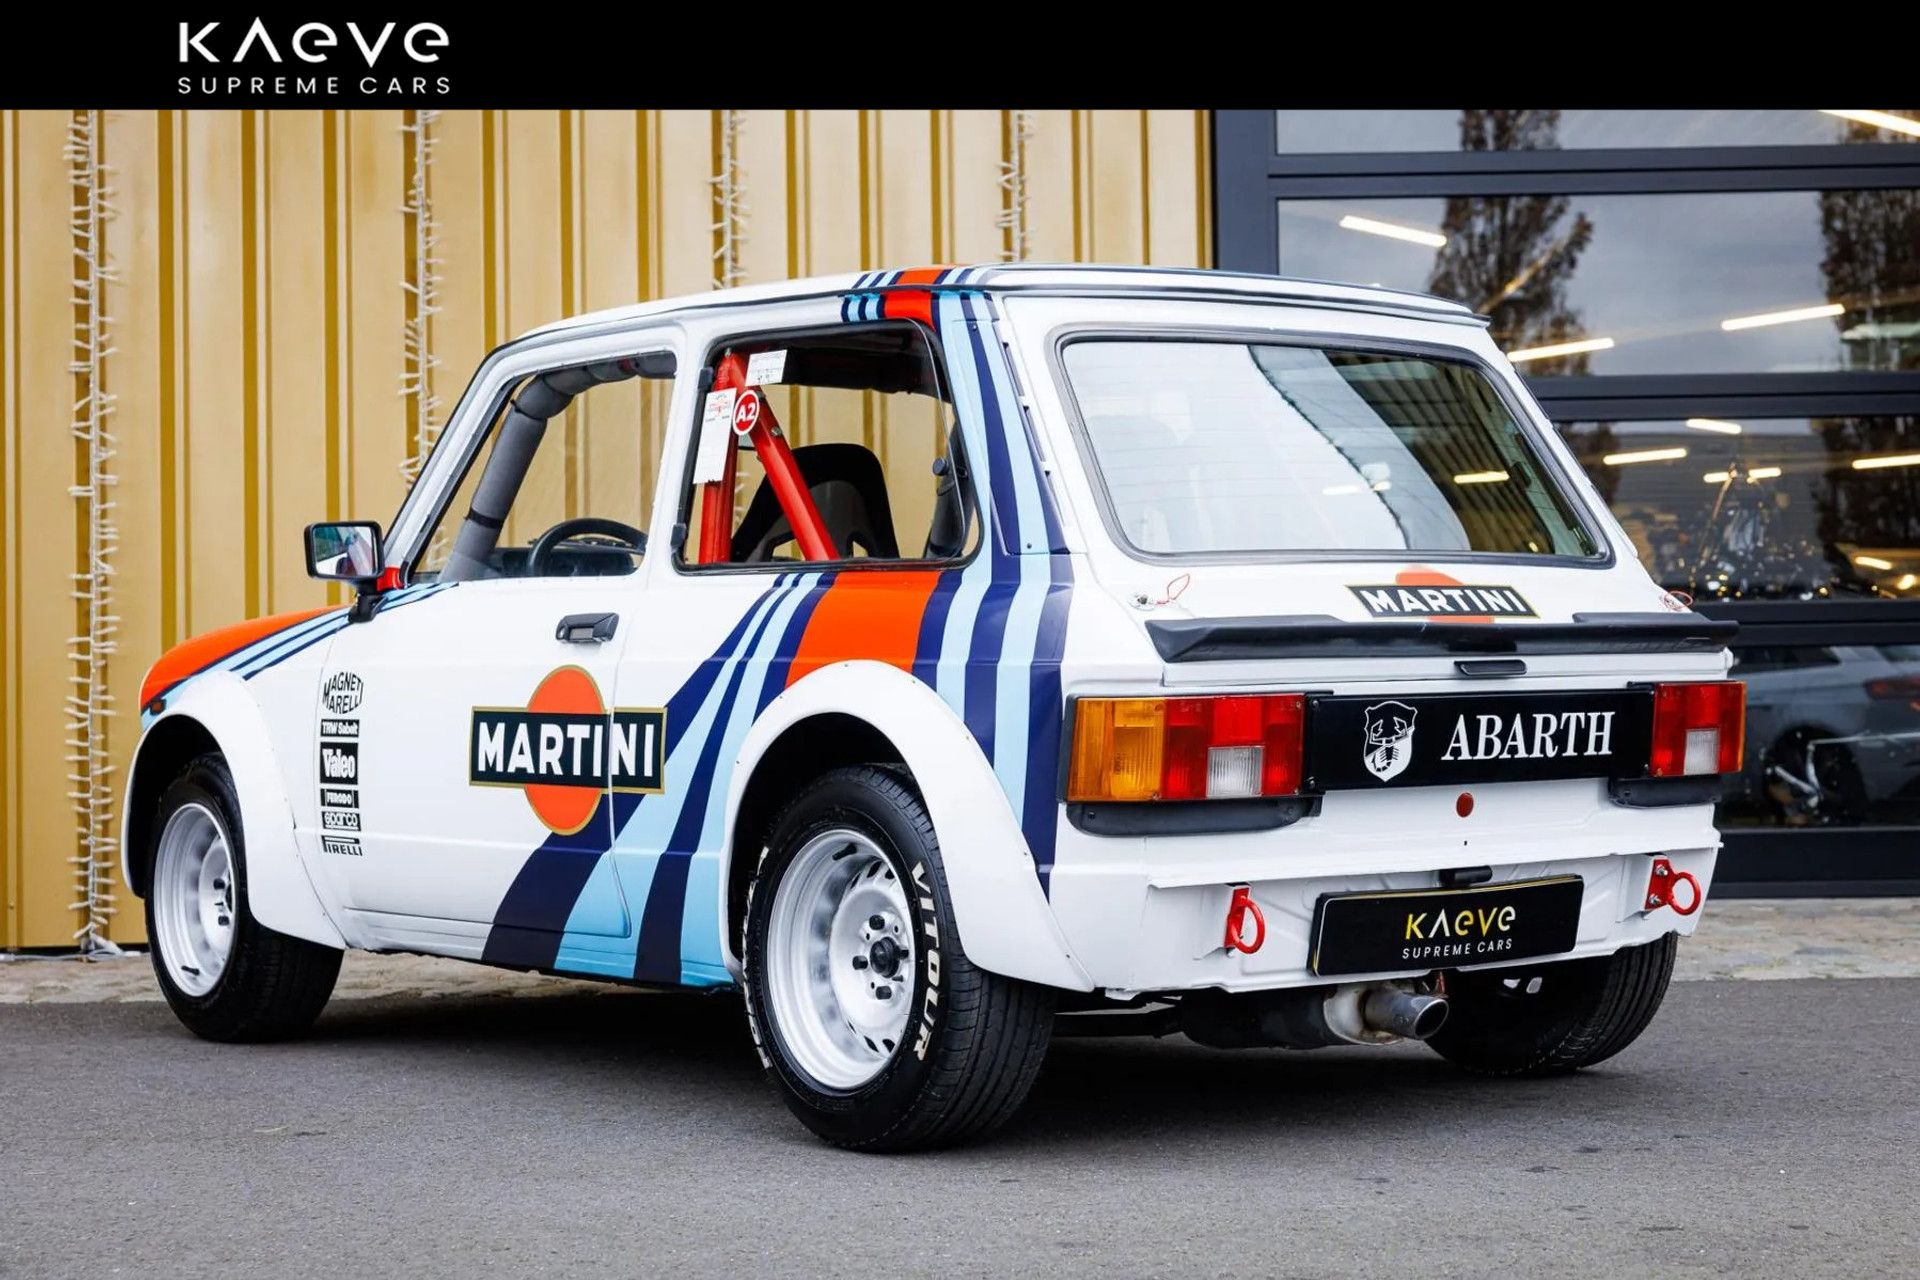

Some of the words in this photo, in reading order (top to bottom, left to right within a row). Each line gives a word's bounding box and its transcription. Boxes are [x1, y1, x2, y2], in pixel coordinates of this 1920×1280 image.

[736, 403, 756, 423] A2
[1361, 589, 1527, 613] MARTINI
[323, 672, 364, 694] MAGNETI
[322, 693, 363, 715] MARELLI
[1441, 712, 1615, 760] ABARTH
[478, 722, 655, 777] MARTINI
[322, 748, 356, 778] Valeo
[324, 811, 358, 826] sparco
[321, 835, 363, 856] PIRELLI
[1402, 943, 1471, 959] SUPREME
[1477, 938, 1513, 952] CARS
[912, 861, 941, 1061] VITOUR
